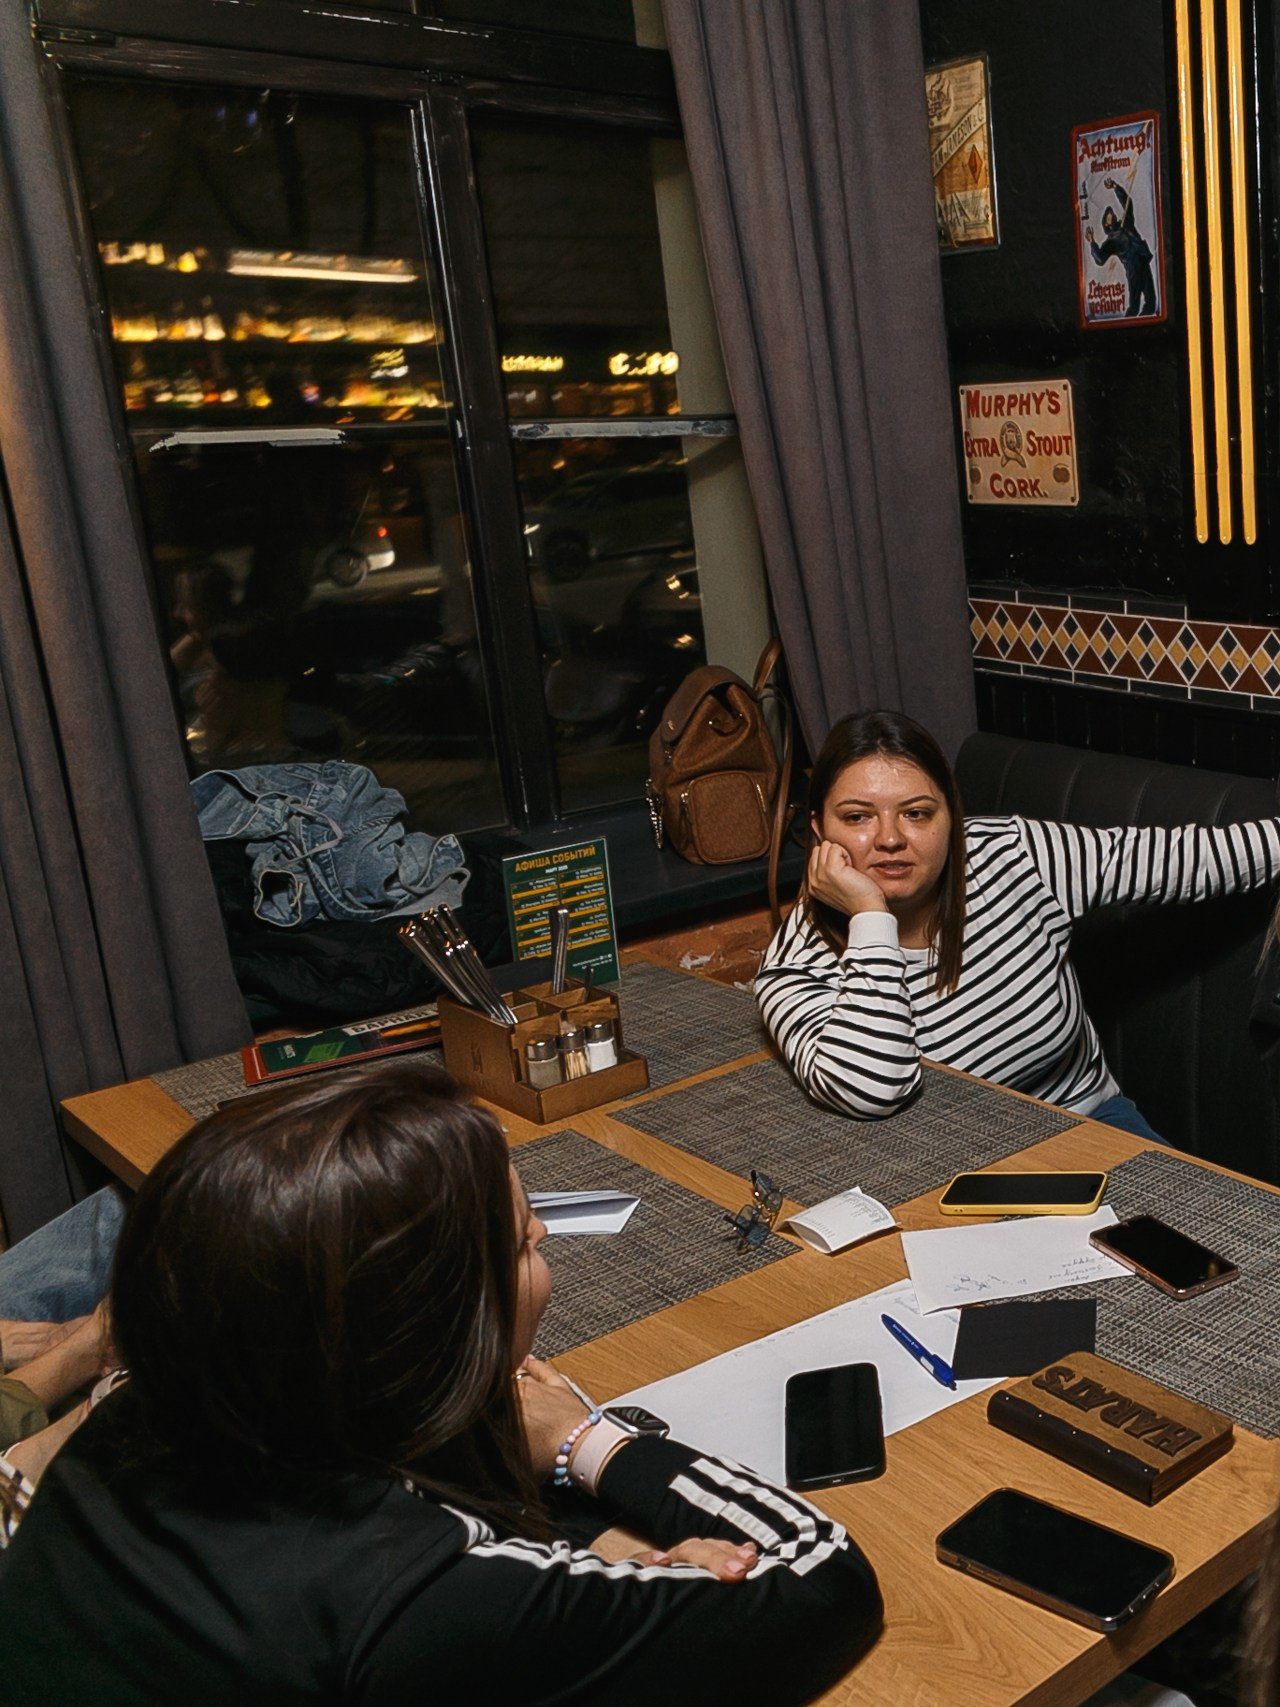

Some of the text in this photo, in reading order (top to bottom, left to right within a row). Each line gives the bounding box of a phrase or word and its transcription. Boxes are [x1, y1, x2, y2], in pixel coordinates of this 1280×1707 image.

[1079, 126, 1152, 164] Achtung!
[966, 388, 1061, 418] MURPHY'S
[965, 430, 1001, 459] EXTRA
[1026, 429, 1072, 457] STOUT
[989, 472, 1048, 499] CORK.
[514, 845, 595, 873] АФИША СОБЫТИЙ
[1031, 1365, 1203, 1457] HARATS
